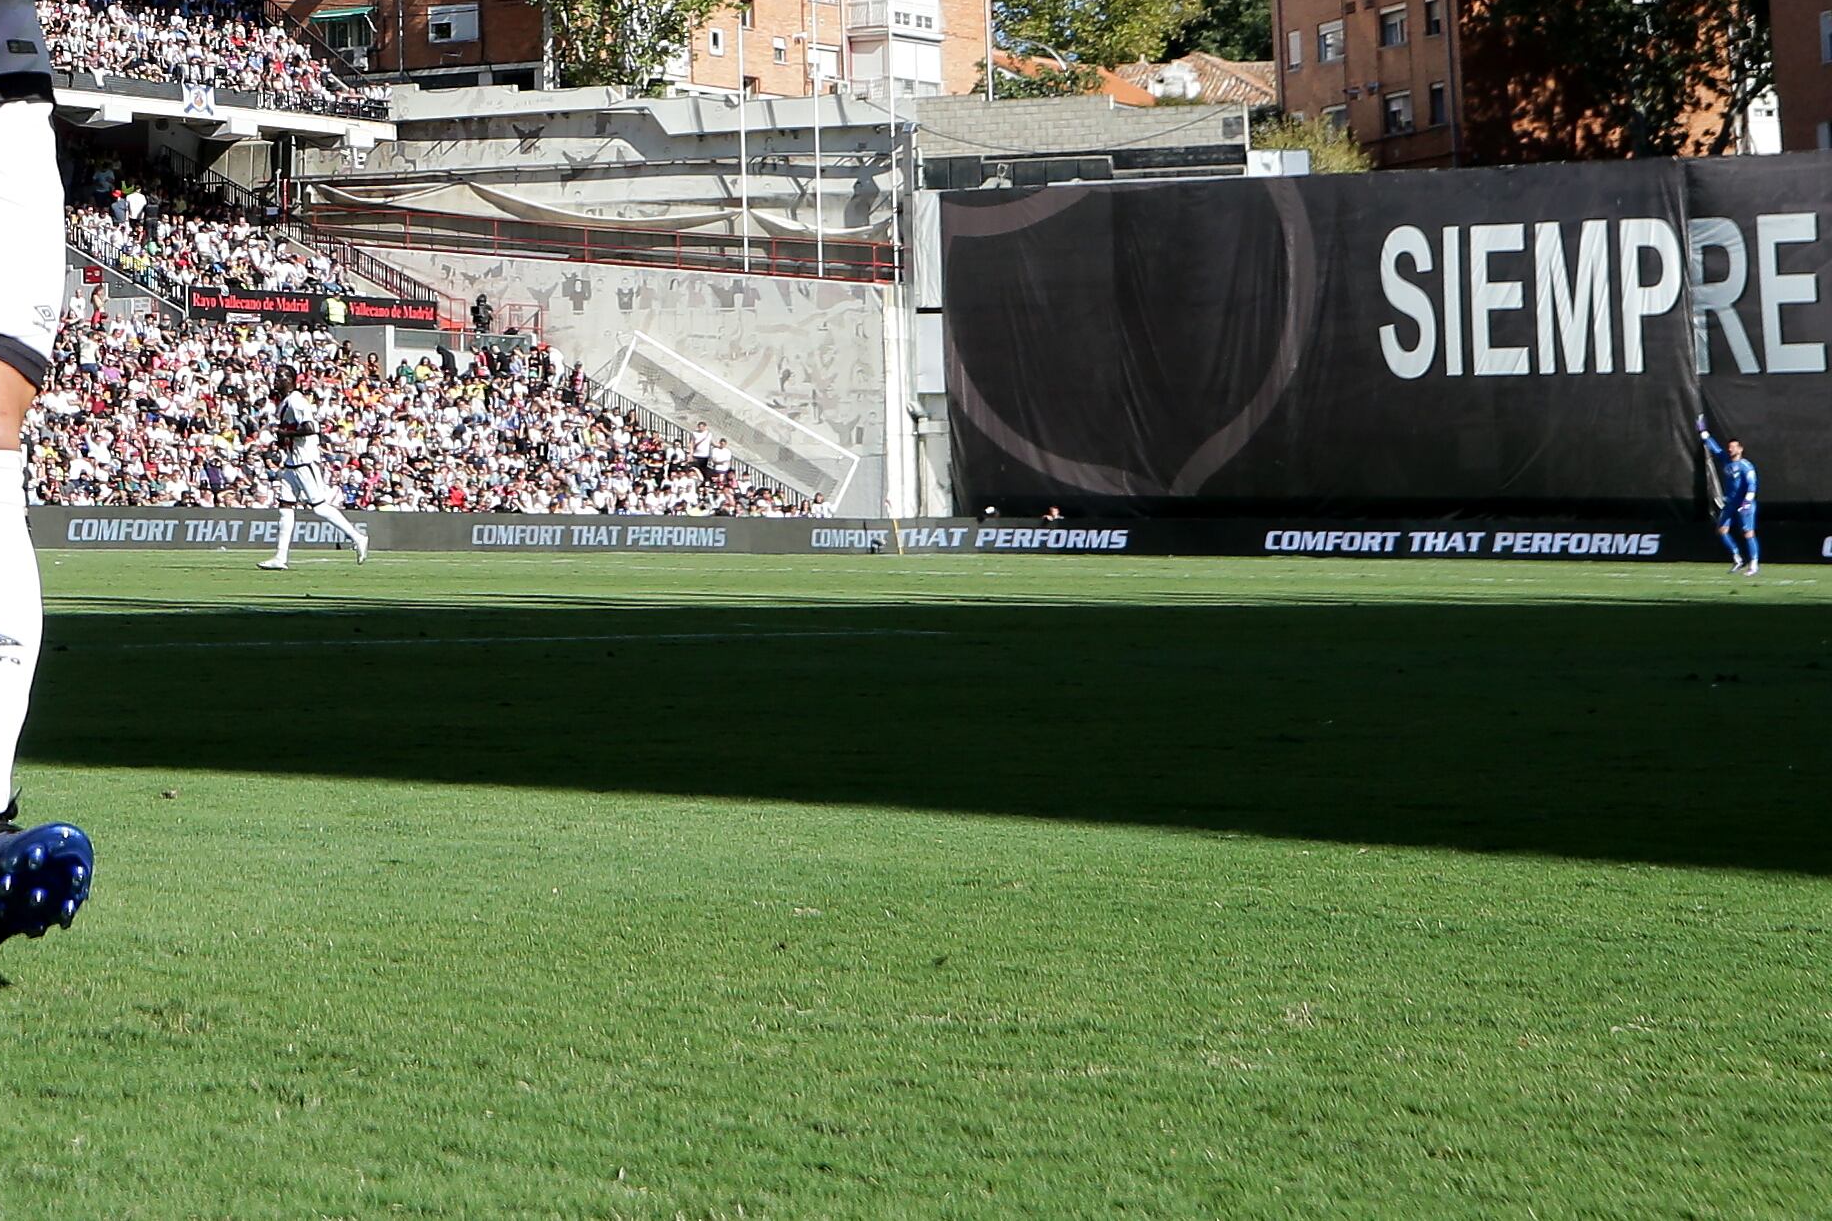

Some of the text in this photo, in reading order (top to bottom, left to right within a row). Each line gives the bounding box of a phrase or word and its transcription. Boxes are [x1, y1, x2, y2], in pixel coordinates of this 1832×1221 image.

[192, 292, 310, 313] Rayo Vallecano de Madrid
[1378, 211, 1828, 380] SIEMPRE
[349, 301, 435, 321] Vallecano de Madrid
[67, 518, 179, 542] COMFORT
[184, 519, 243, 542] THAT
[471, 524, 727, 547] COMFORT THAT PERFORMS
[974, 529, 1129, 550] PERFORMS
[1264, 530, 1661, 555] COMFORT THAT PERFORMS
